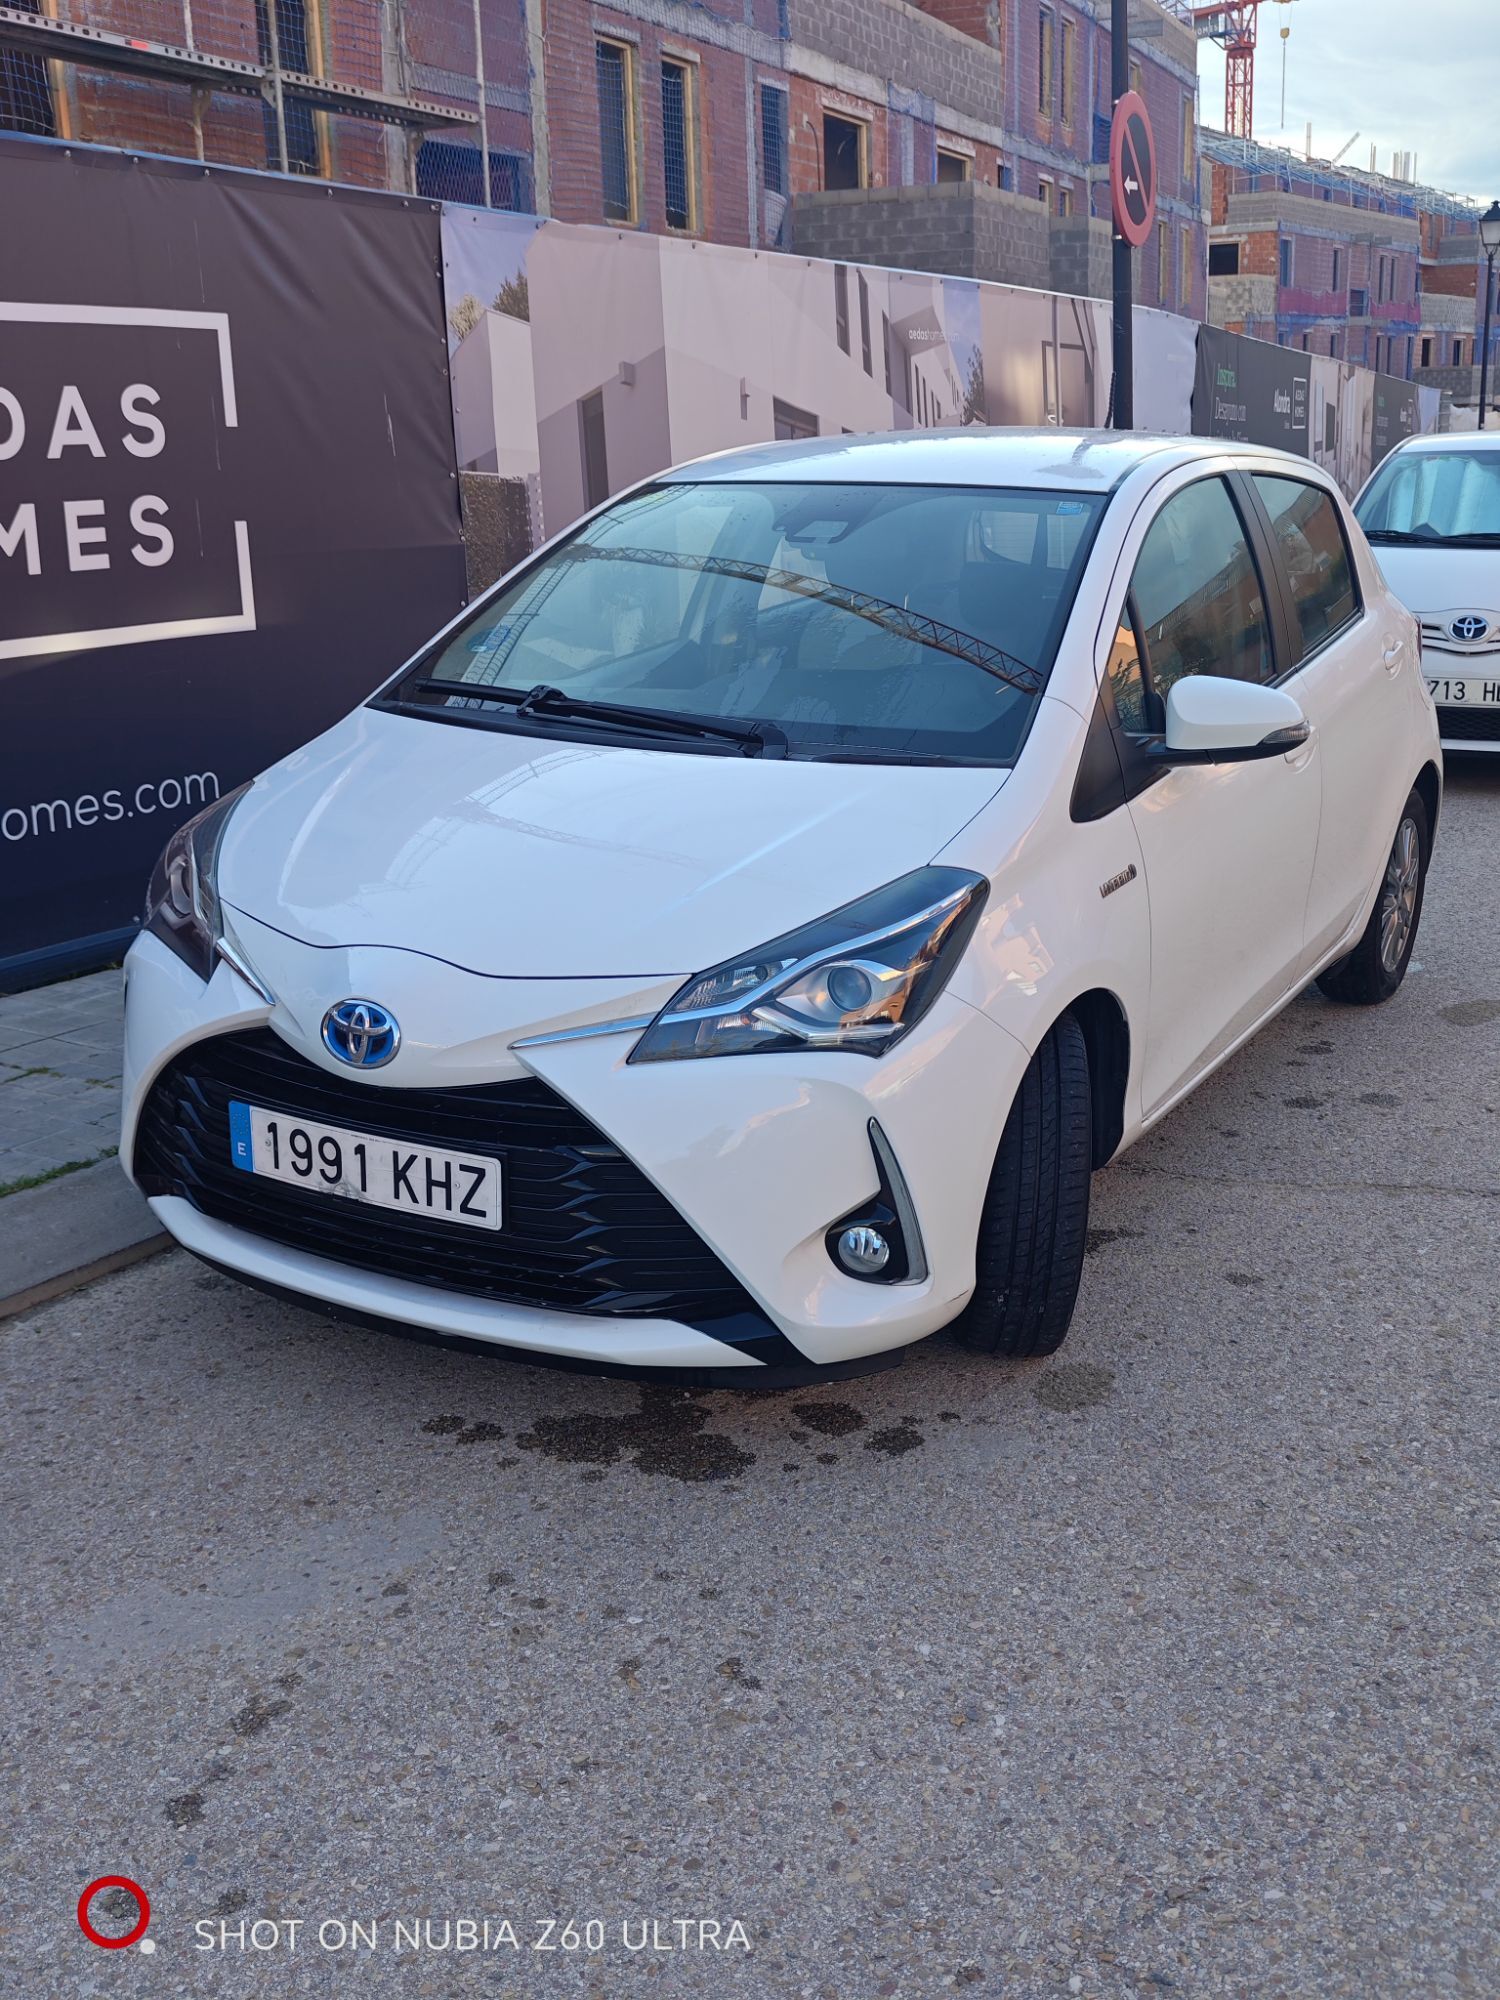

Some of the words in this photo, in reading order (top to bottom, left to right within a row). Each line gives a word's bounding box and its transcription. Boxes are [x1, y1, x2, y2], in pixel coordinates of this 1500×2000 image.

[1428, 680, 1466, 701] 713
[1, 771, 220, 841] omes.com
[237, 1142, 247, 1156] E
[267, 1121, 367, 1193] 1991
[392, 1150, 487, 1218] KHZ
